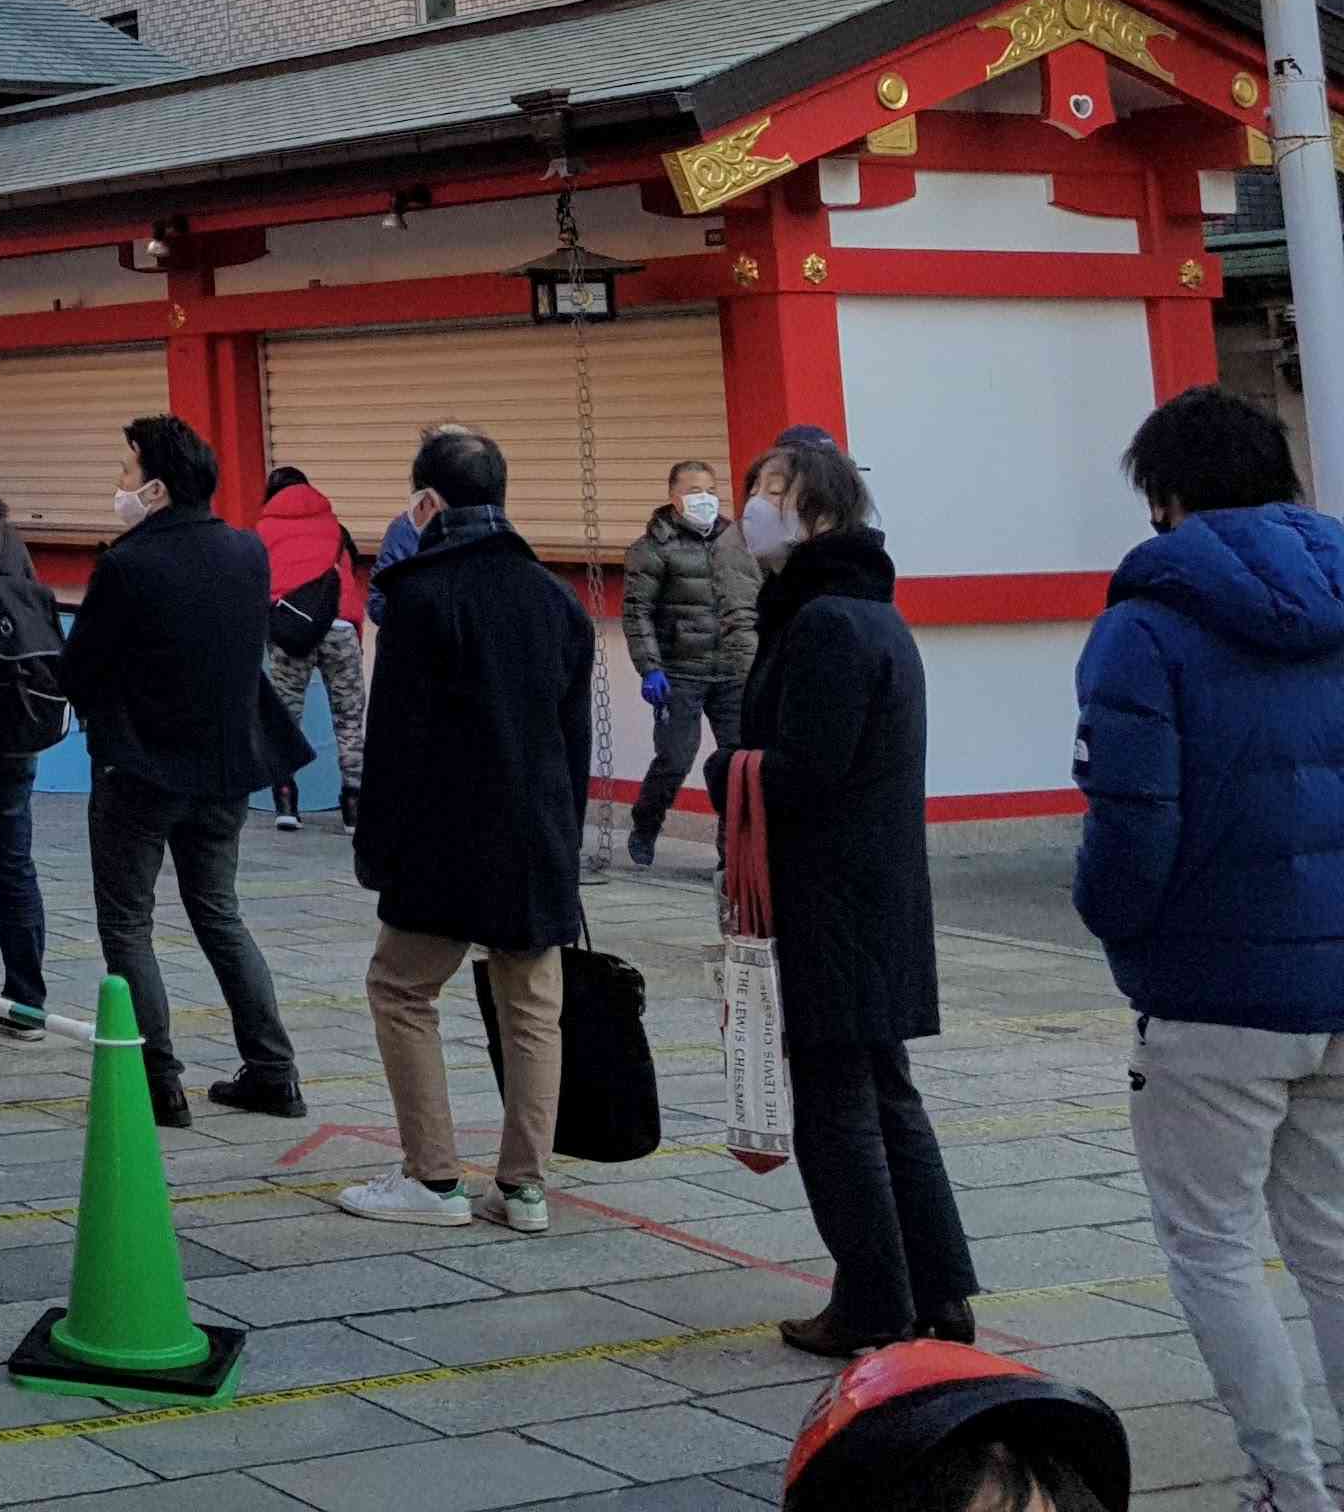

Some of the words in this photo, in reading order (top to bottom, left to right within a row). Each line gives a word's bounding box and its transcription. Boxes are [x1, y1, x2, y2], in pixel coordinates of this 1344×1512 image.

[737, 969, 749, 998] THE
[735, 1000, 747, 1042] LEWIS
[760, 983, 775, 1045] CHESSM
[734, 1048, 746, 1124] CHESSMEN
[764, 1051, 776, 1094] LEWIS
[766, 1101, 777, 1128] THE
